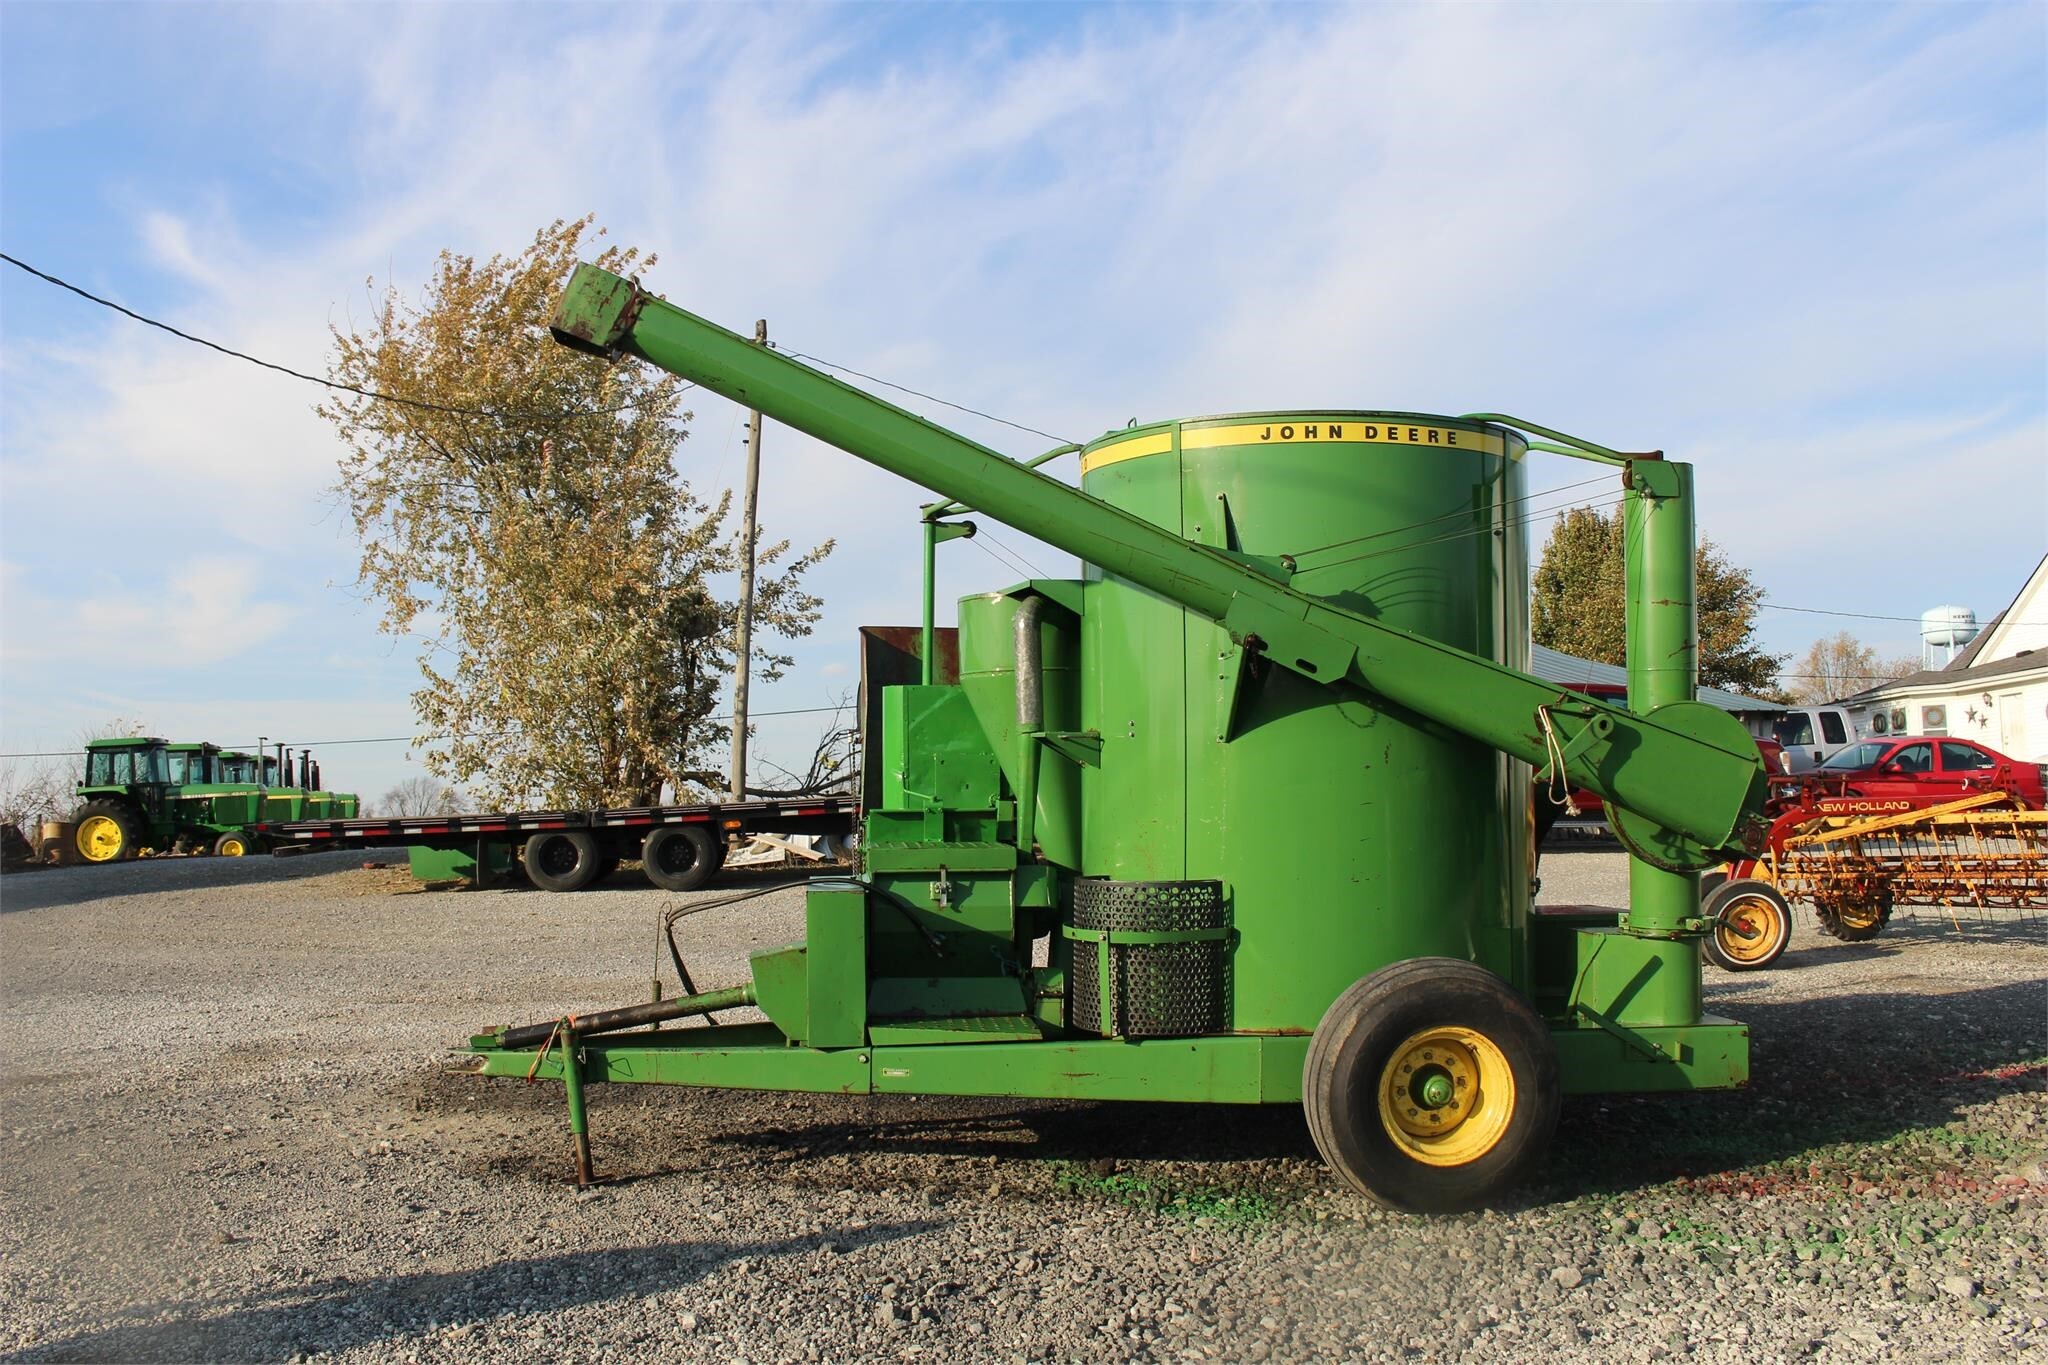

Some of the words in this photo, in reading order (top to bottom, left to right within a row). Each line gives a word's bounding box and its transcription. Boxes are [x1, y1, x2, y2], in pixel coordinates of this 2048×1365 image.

[1261, 425, 1342, 440] JOHN
[1365, 425, 1457, 444] DEERE
[1848, 801, 1910, 811] HOLLAND
